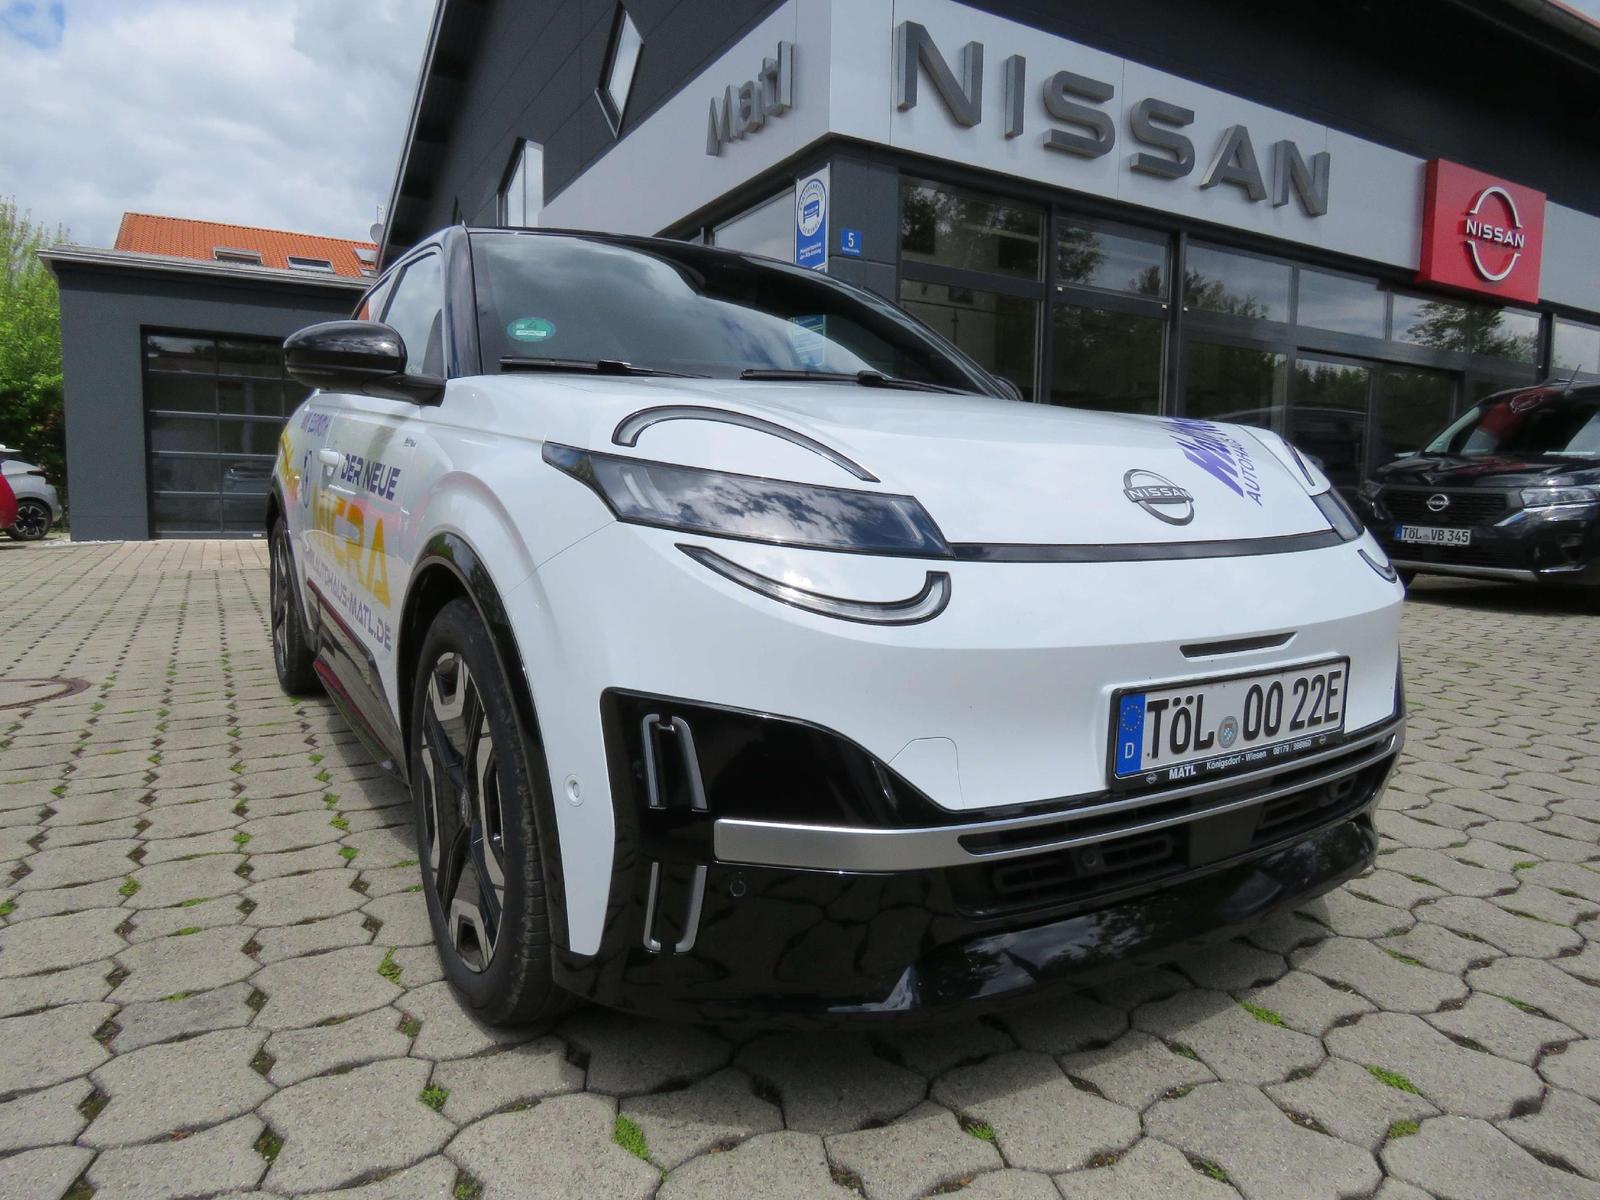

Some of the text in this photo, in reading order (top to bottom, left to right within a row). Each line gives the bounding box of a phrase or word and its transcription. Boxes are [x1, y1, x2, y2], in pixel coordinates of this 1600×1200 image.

[706, 40, 793, 156] Matl
[898, 21, 1331, 216] NISSAN
[848, 232, 855, 248] 5
[1466, 219, 1525, 248] NISSAN
[340, 453, 401, 500] DER NEUE
[1128, 487, 1192, 499] NISSAN
[1402, 527, 1422, 540] TÖL
[1431, 529, 1445, 541] VB
[1447, 530, 1469, 543] 345
[1146, 694, 1215, 759] TÖL
[1289, 670, 1342, 732] 22E
[1125, 742, 1135, 759] D
[1168, 764, 1197, 780] MATL
[1206, 755, 1241, 770] Königsdorf
[1245, 751, 1267, 762] Wiesen
